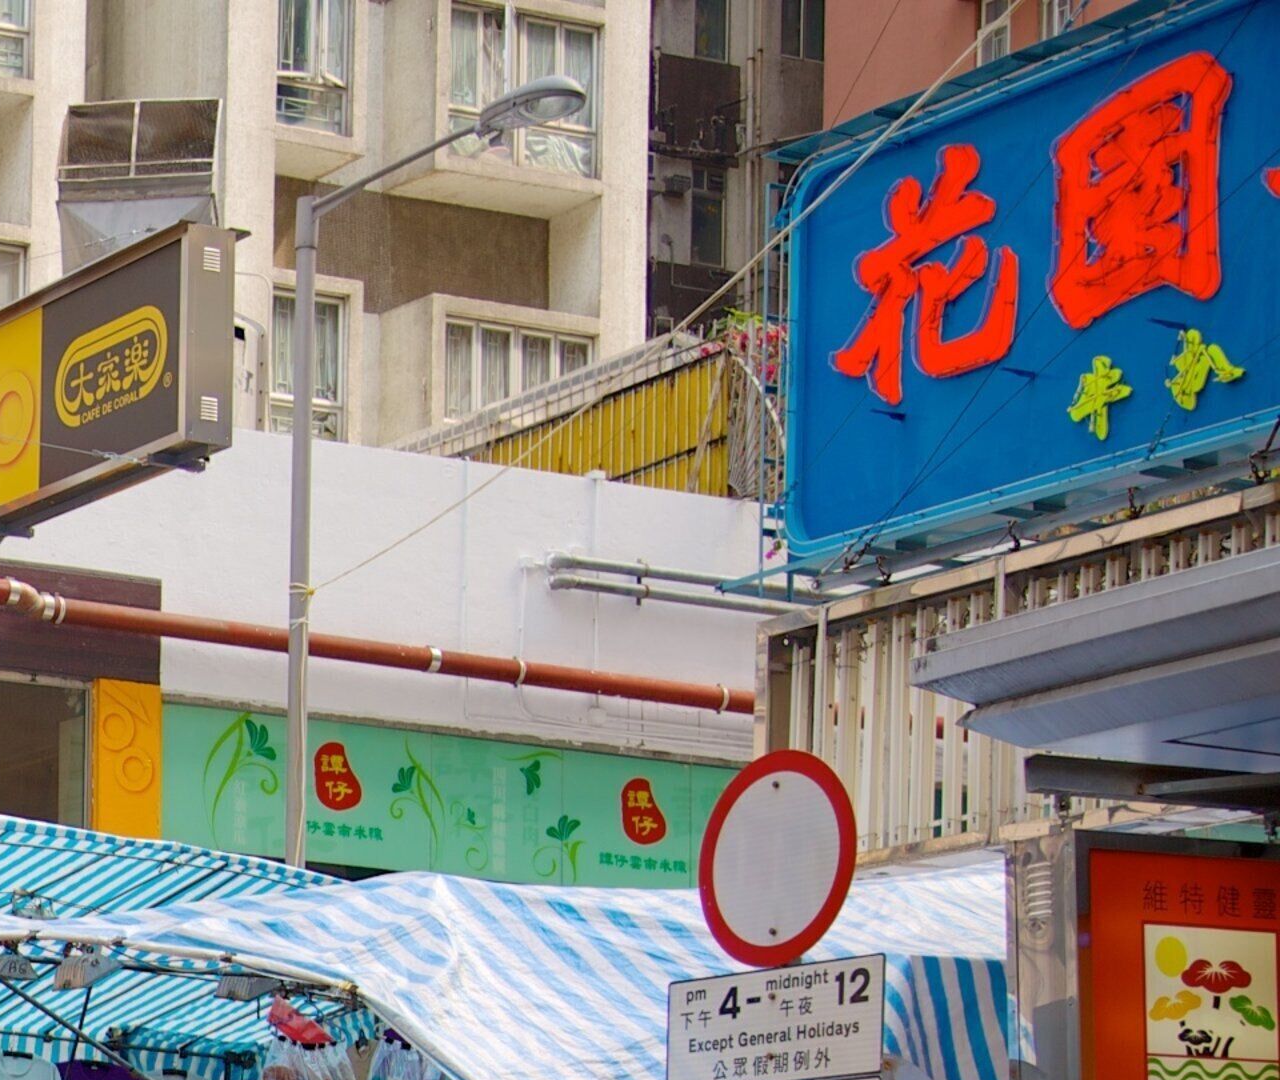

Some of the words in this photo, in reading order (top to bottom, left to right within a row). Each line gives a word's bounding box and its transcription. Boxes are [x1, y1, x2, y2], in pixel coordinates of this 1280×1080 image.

[102, 403, 113, 416] DE
[114, 392, 140, 411] CORAL
[320, 752, 352, 801] 譚仔
[627, 790, 657, 835] 譚仔
[1142, 880, 1277, 920] 維特健靈
[686, 989, 707, 1005] pm
[766, 969, 828, 991] midnight
[836, 968, 870, 1005] 12
[681, 1010, 712, 1030] 下午
[780, 997, 813, 1017] 午夜
[689, 1034, 733, 1053] Except
[738, 1027, 791, 1047] General
[797, 1021, 859, 1041] Holidays
[713, 1047, 830, 1080] 公眾假期例外
